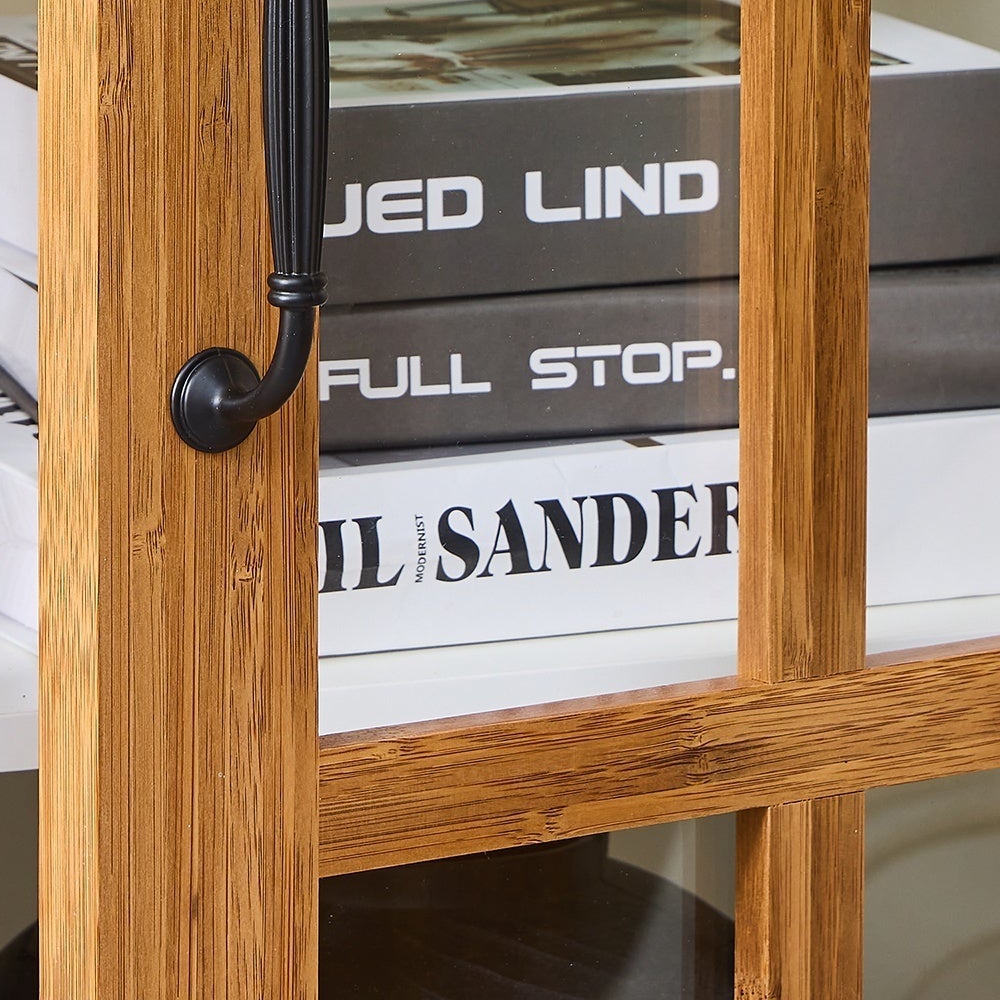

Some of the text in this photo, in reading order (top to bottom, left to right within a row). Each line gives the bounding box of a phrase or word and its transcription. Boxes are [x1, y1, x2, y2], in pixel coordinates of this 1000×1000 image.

[524, 159, 721, 224] LIND
[319, 340, 737, 402] FULL STOP.
[414, 513, 427, 584] MODERNIST
